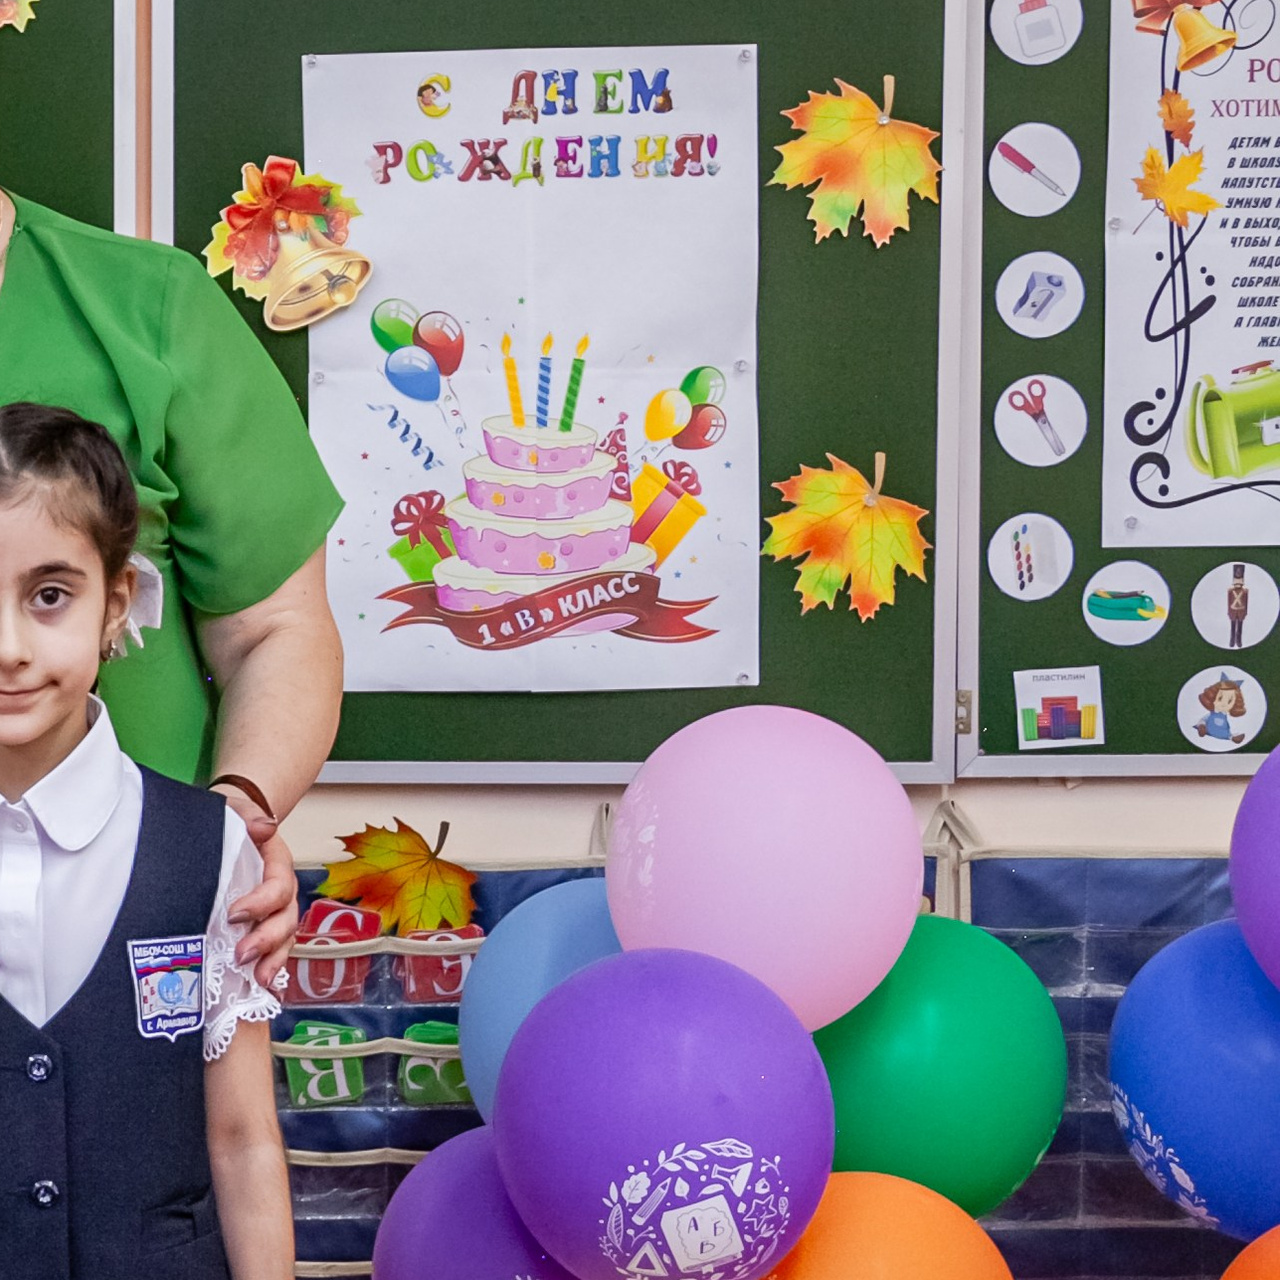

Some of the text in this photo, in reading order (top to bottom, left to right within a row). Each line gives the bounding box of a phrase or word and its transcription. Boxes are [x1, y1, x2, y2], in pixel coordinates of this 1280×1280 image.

[1247, 58, 1280, 83] РО
[417, 68, 674, 125] С ДНЕМ
[1227, 136, 1272, 150] ДЕТЯМ
[366, 134, 720, 187] РОЖДЕНИЯ!
[1227, 157, 1237, 168] В
[1225, 197, 1272, 208] УМНУЮ
[1243, 217, 1280, 230] ВЫХО
[1230, 236, 1272, 248] ЧТОБЫ
[1246, 316, 1280, 328] ГЛАВ
[478, 623, 496, 646] 1
[558, 572, 640, 618] КЛАСС
[1032, 673, 1086, 682] пластилин
[134, 944, 184, 958] МБОУ-СОШ
